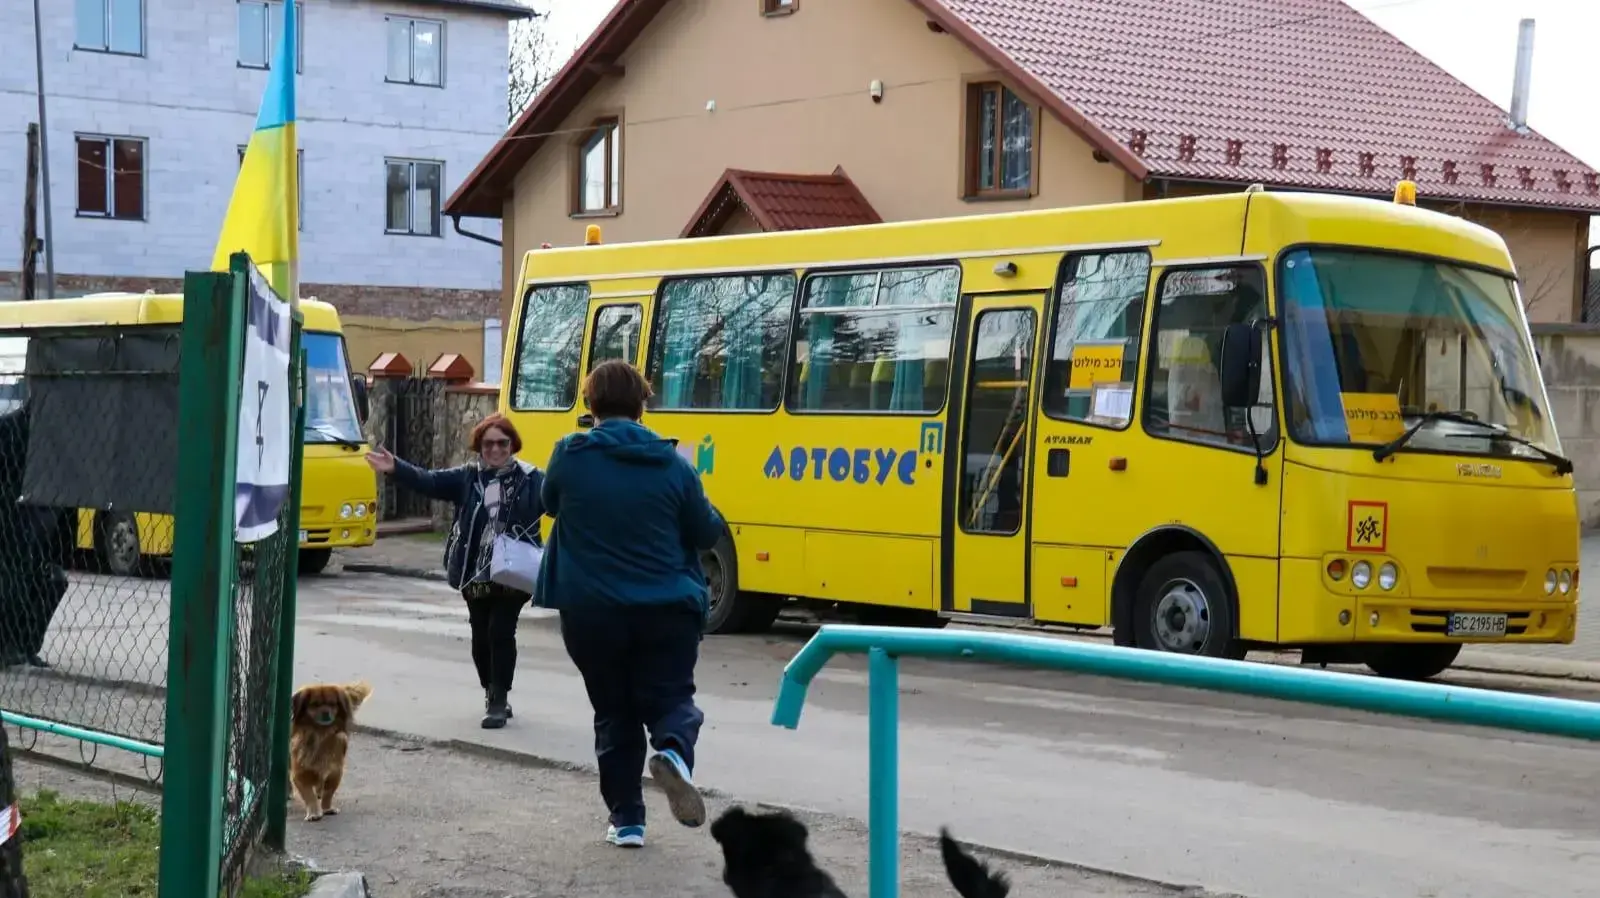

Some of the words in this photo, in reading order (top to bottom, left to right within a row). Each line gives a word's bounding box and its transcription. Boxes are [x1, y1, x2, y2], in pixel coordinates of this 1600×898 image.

[1074, 356, 1101, 368] מילוט
[1104, 358, 1121, 368] רכב
[1043, 435, 1093, 444] ATAMAN
[763, 445, 918, 486] АВТОБУС
[1454, 616, 1468, 630] BC
[1470, 616, 1491, 631] 2195
